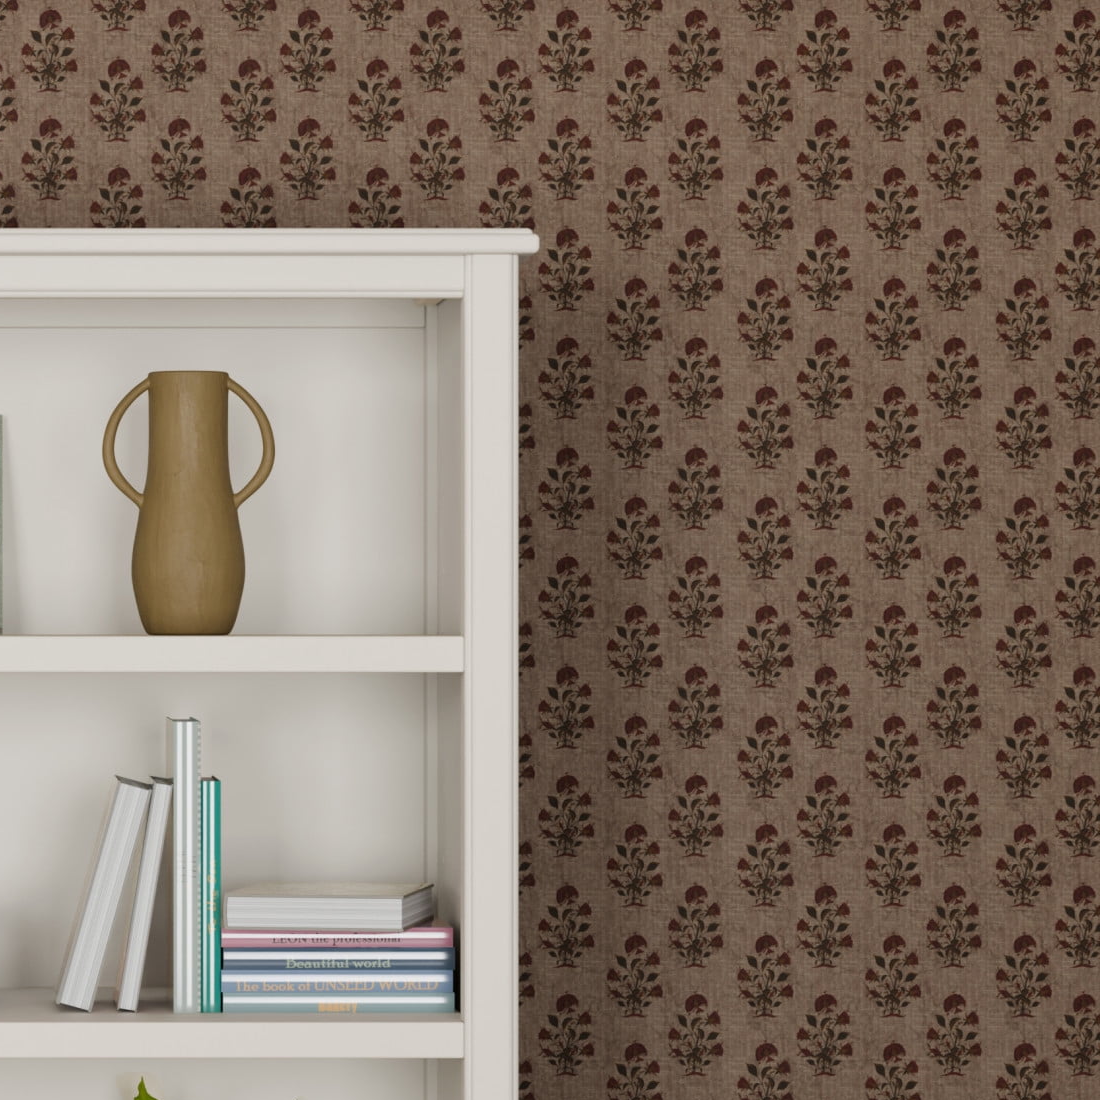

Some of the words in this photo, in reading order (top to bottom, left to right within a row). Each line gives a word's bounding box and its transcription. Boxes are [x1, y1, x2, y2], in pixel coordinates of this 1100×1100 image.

[286, 958, 350, 968] Beautiful
[353, 958, 392, 968] world
[235, 980, 259, 992] The
[262, 980, 296, 992] book
